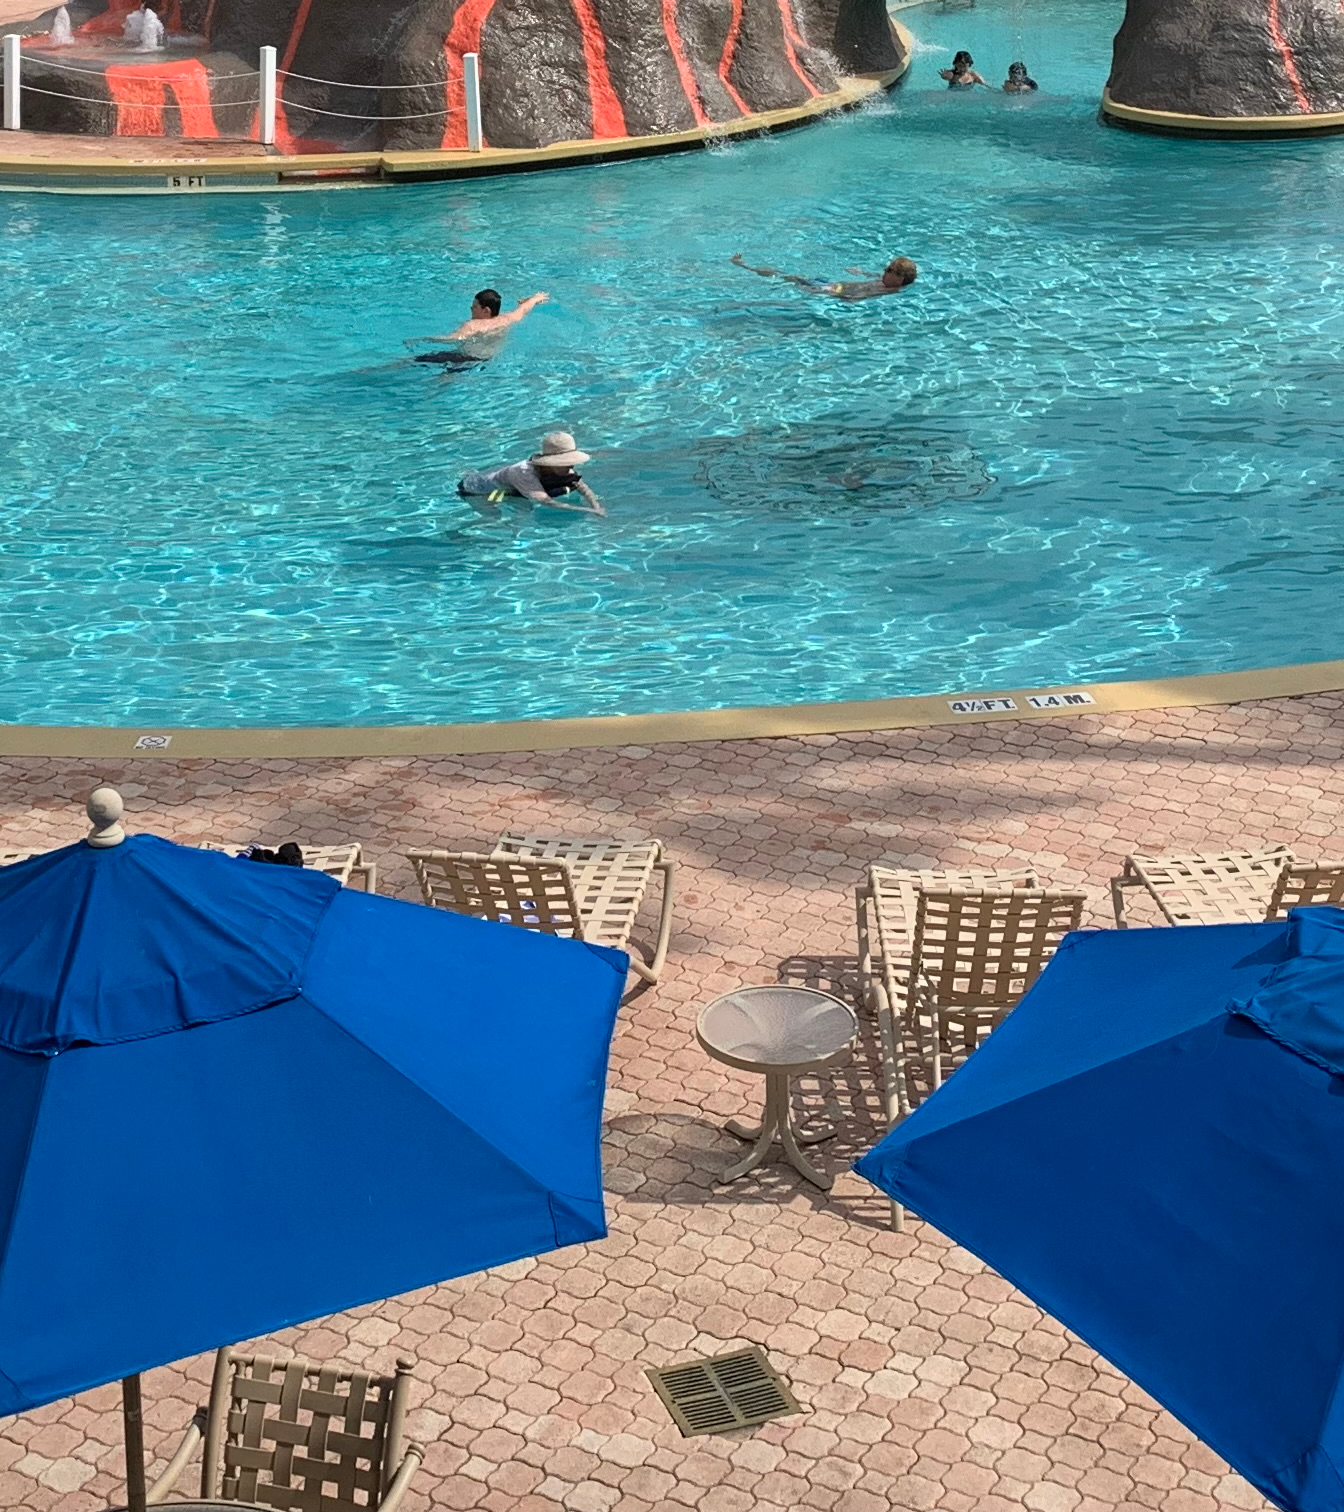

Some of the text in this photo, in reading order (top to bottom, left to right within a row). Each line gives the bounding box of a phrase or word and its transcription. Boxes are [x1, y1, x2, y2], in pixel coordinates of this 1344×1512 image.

[172, 175, 204, 187] 5 FT
[1029, 696, 1060, 708] 1.4
[1063, 694, 1091, 705] M.
